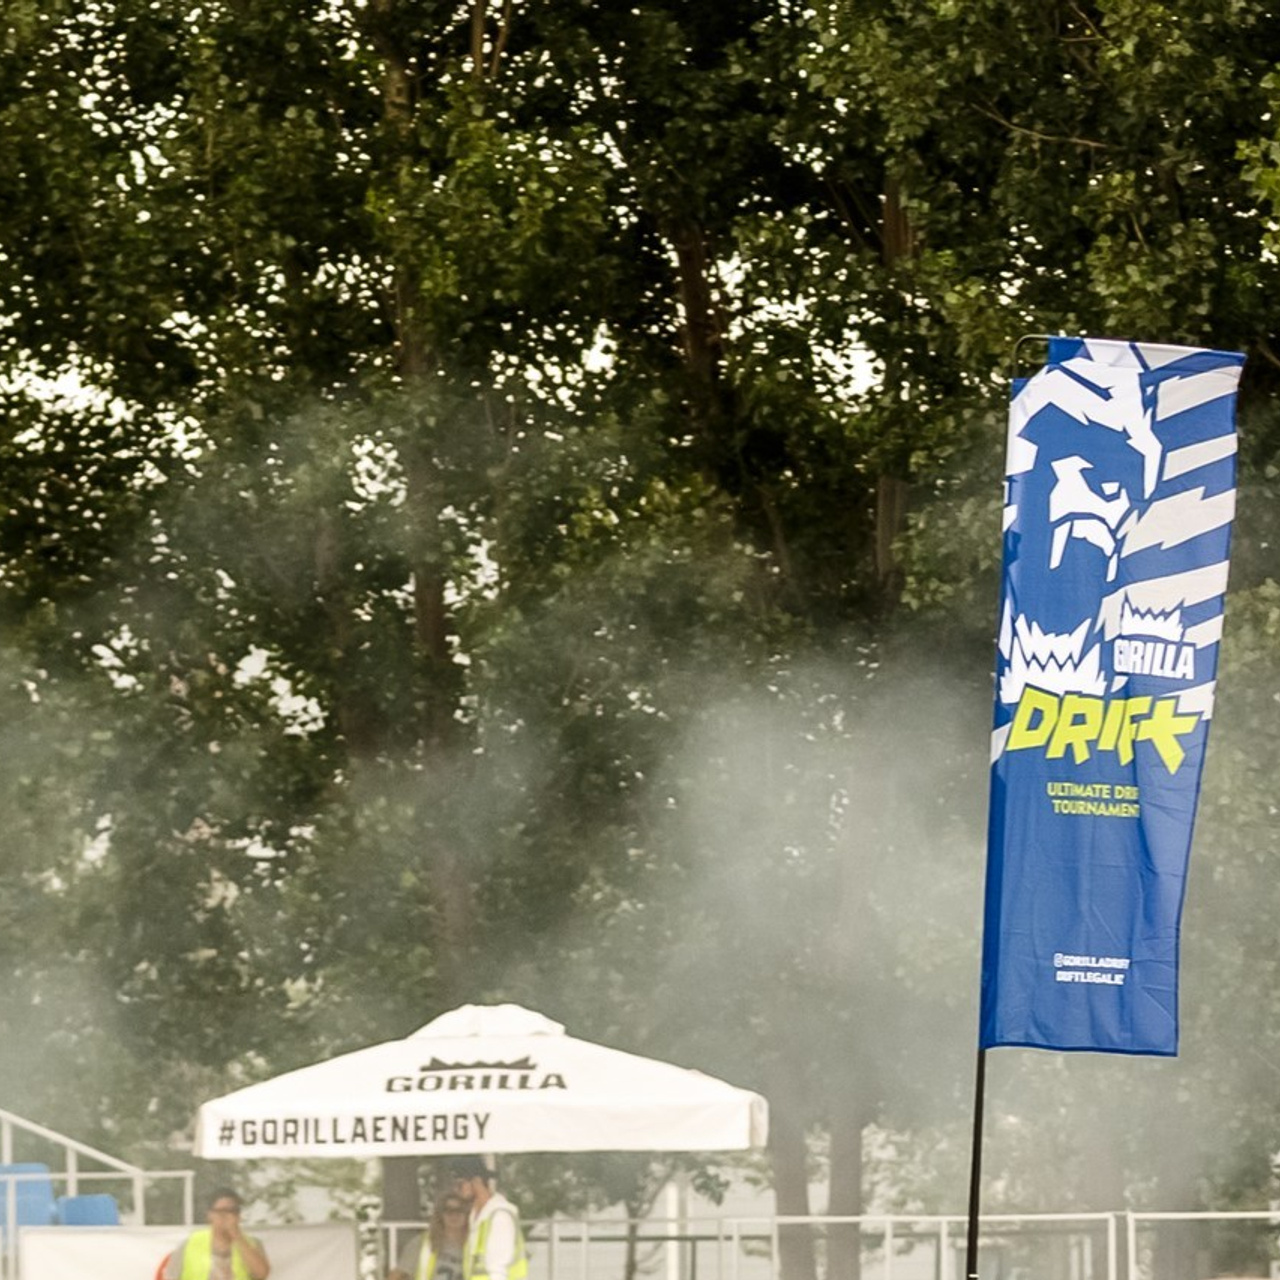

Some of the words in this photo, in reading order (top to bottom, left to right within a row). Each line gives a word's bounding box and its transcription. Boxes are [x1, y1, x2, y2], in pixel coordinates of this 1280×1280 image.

[1005, 687, 1200, 776] DRIFT
[1047, 782, 1111, 798] ULTIMATE
[1052, 800, 1140, 818] TOURNAMEN
[385, 1073, 568, 1093] GORILLA
[218, 1112, 492, 1147] #GORILLAENERGY
